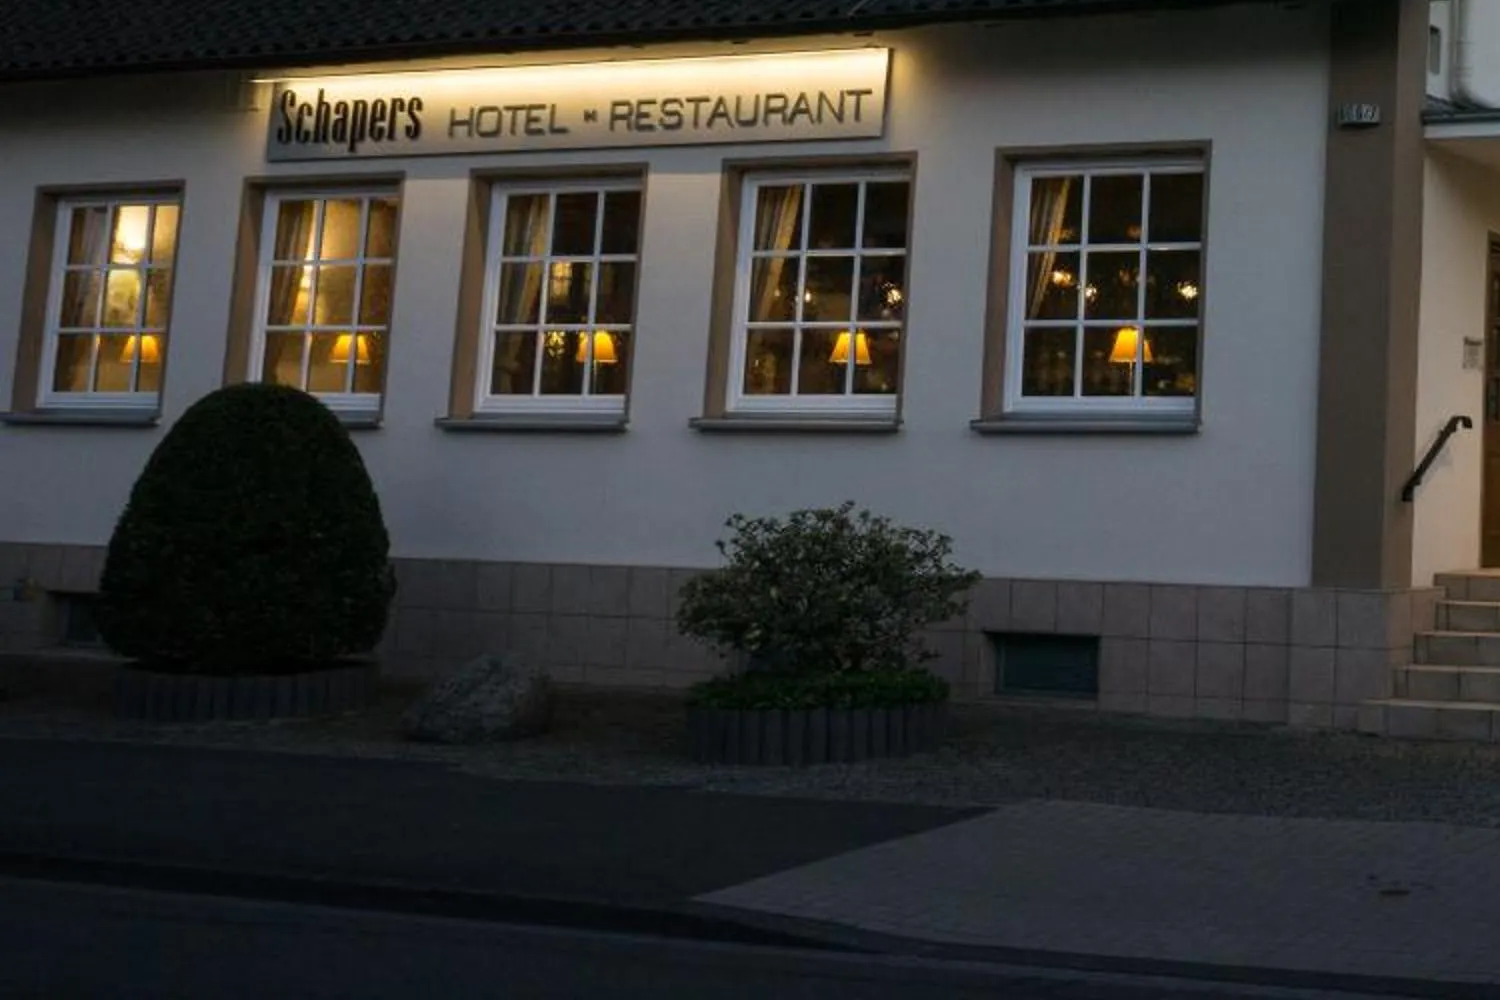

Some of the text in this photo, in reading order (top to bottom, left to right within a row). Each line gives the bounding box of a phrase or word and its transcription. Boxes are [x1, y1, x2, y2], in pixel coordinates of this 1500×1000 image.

[276, 88, 873, 153] Schapers HOTEL RESTAURANT
